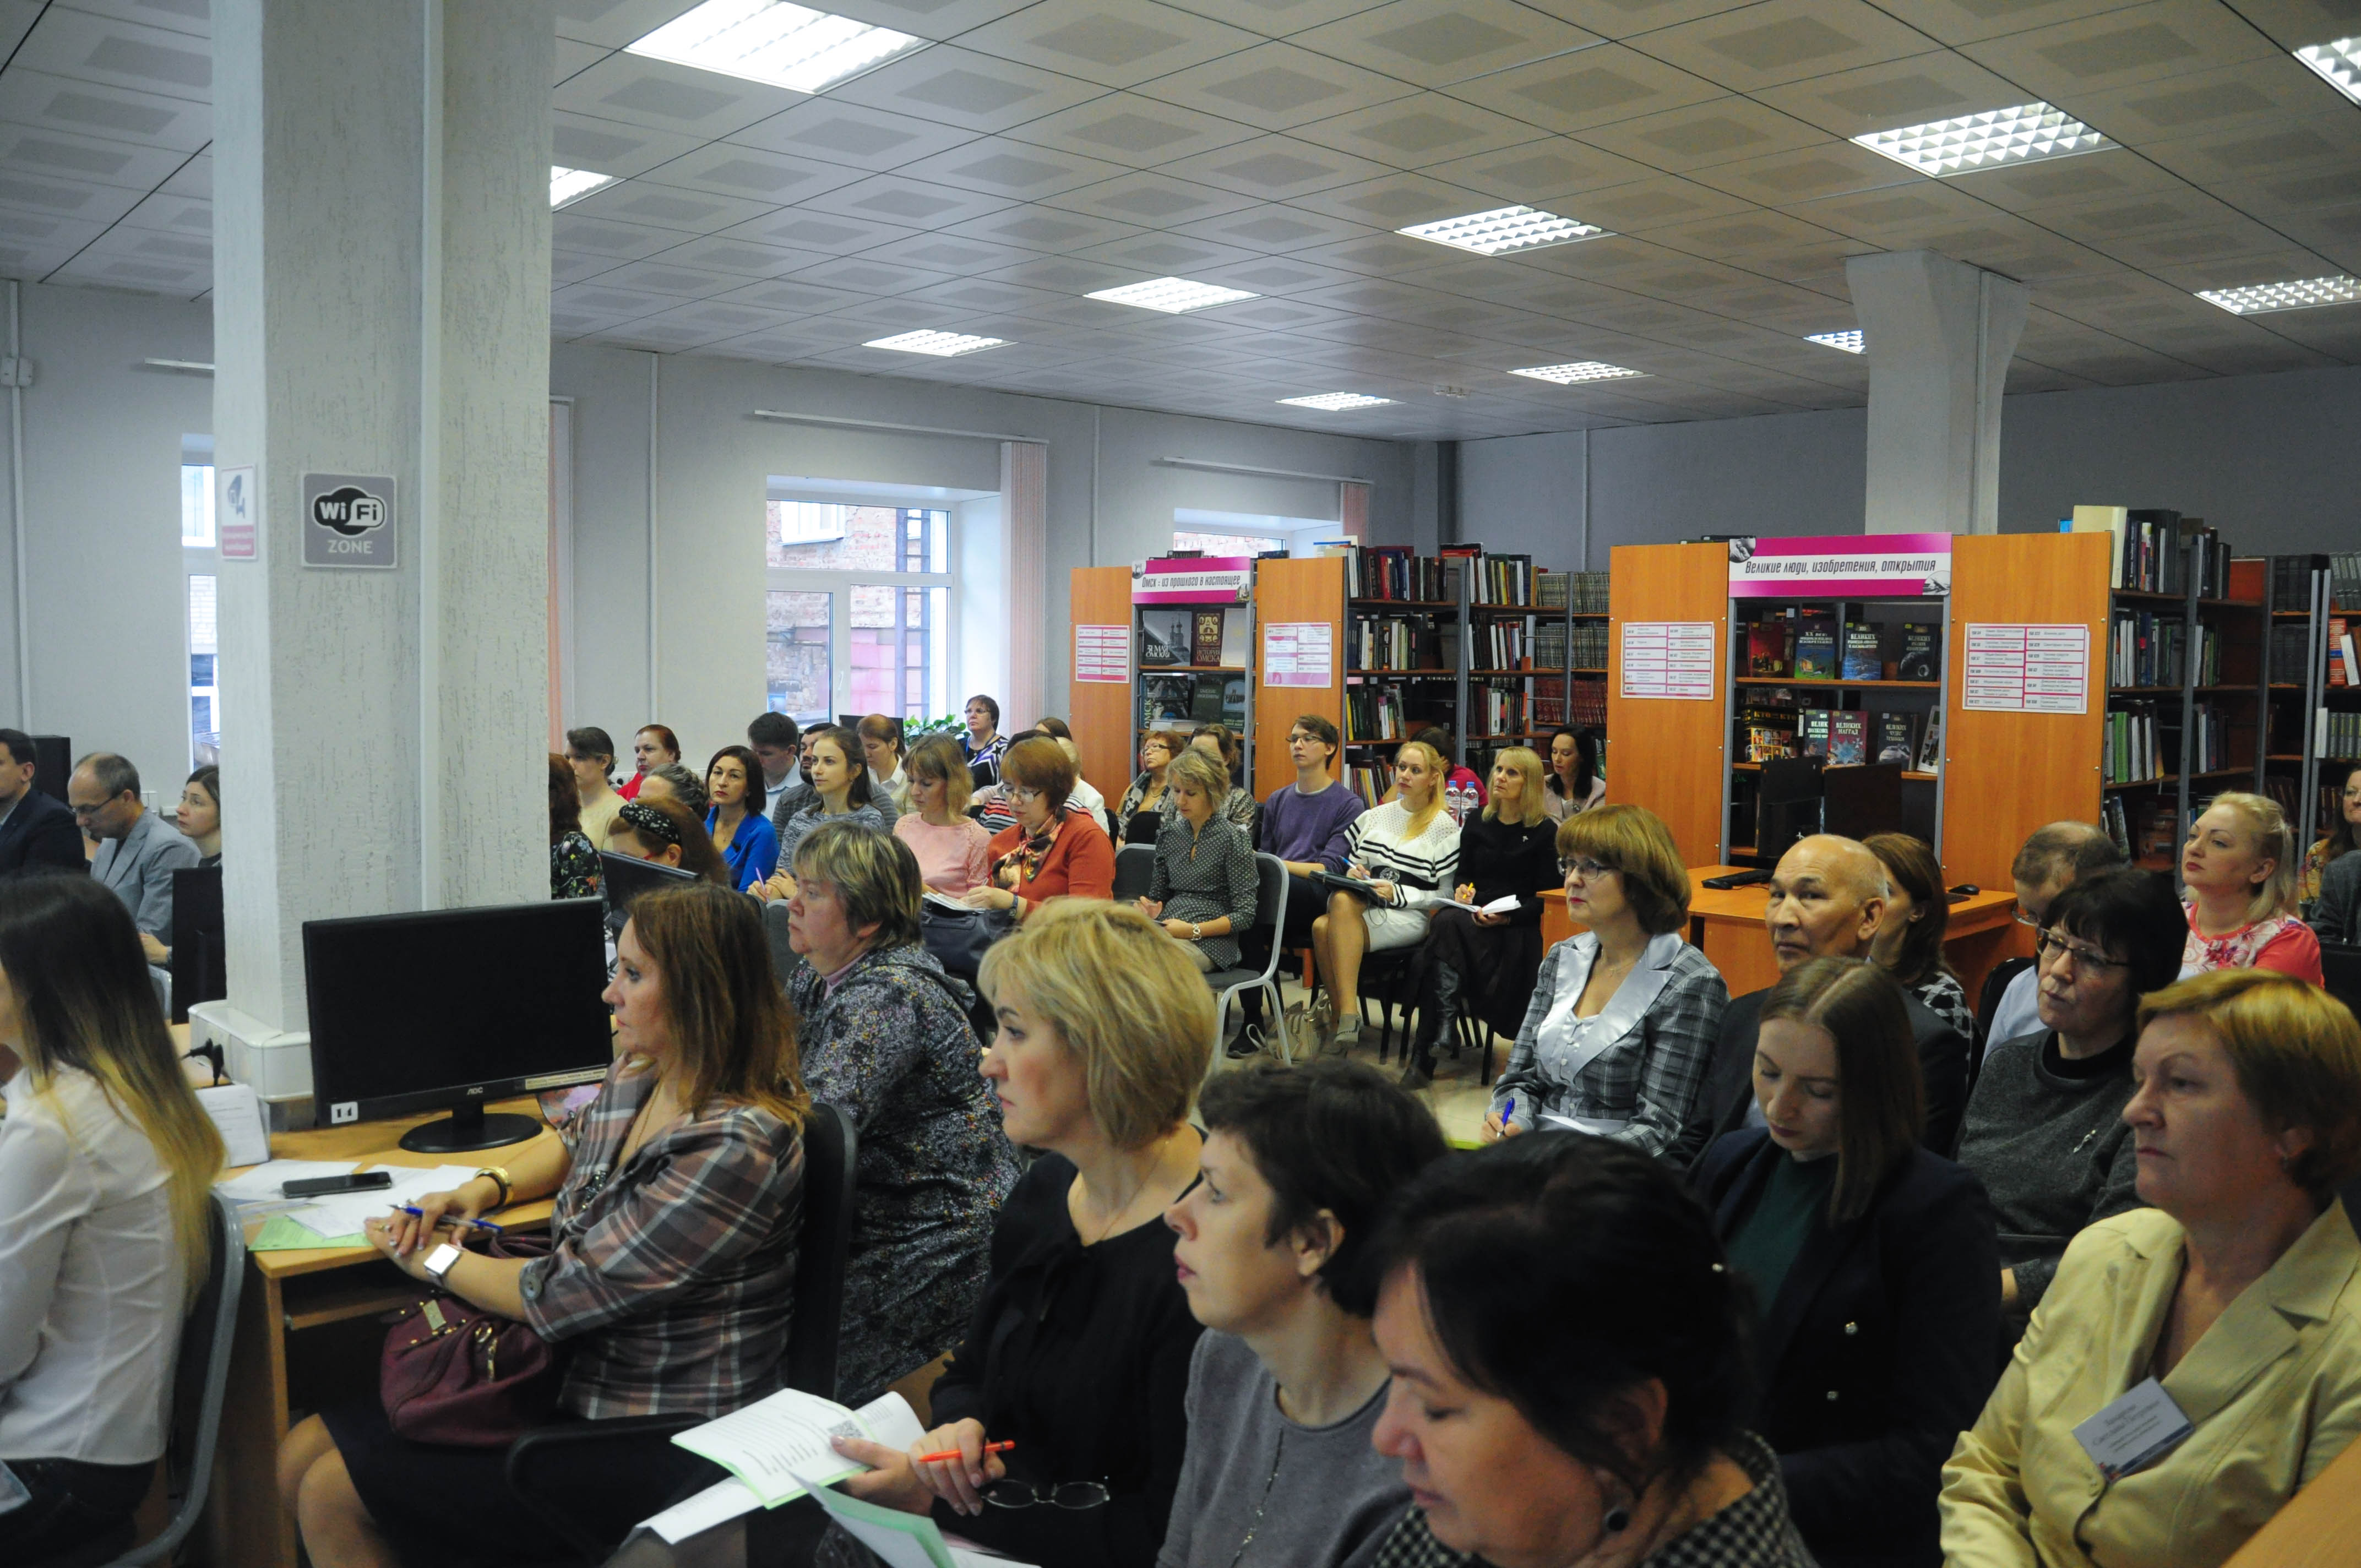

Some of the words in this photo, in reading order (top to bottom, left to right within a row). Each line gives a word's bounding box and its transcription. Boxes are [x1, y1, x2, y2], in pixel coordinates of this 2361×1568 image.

[327, 540, 373, 554] ZONE
[1745, 560, 1781, 574] Великие
[1783, 562, 1808, 575] люди,
[1812, 559, 1878, 574] изобретения,
[1882, 559, 1935, 574] открытия
[1142, 576, 1156, 587] Омск
[1162, 578, 1168, 587] из
[1170, 576, 1198, 589] прошлого
[1200, 576, 1203, 586] в
[1205, 575, 1241, 587] настоящее
[467, 1086, 483, 1095] AOC
